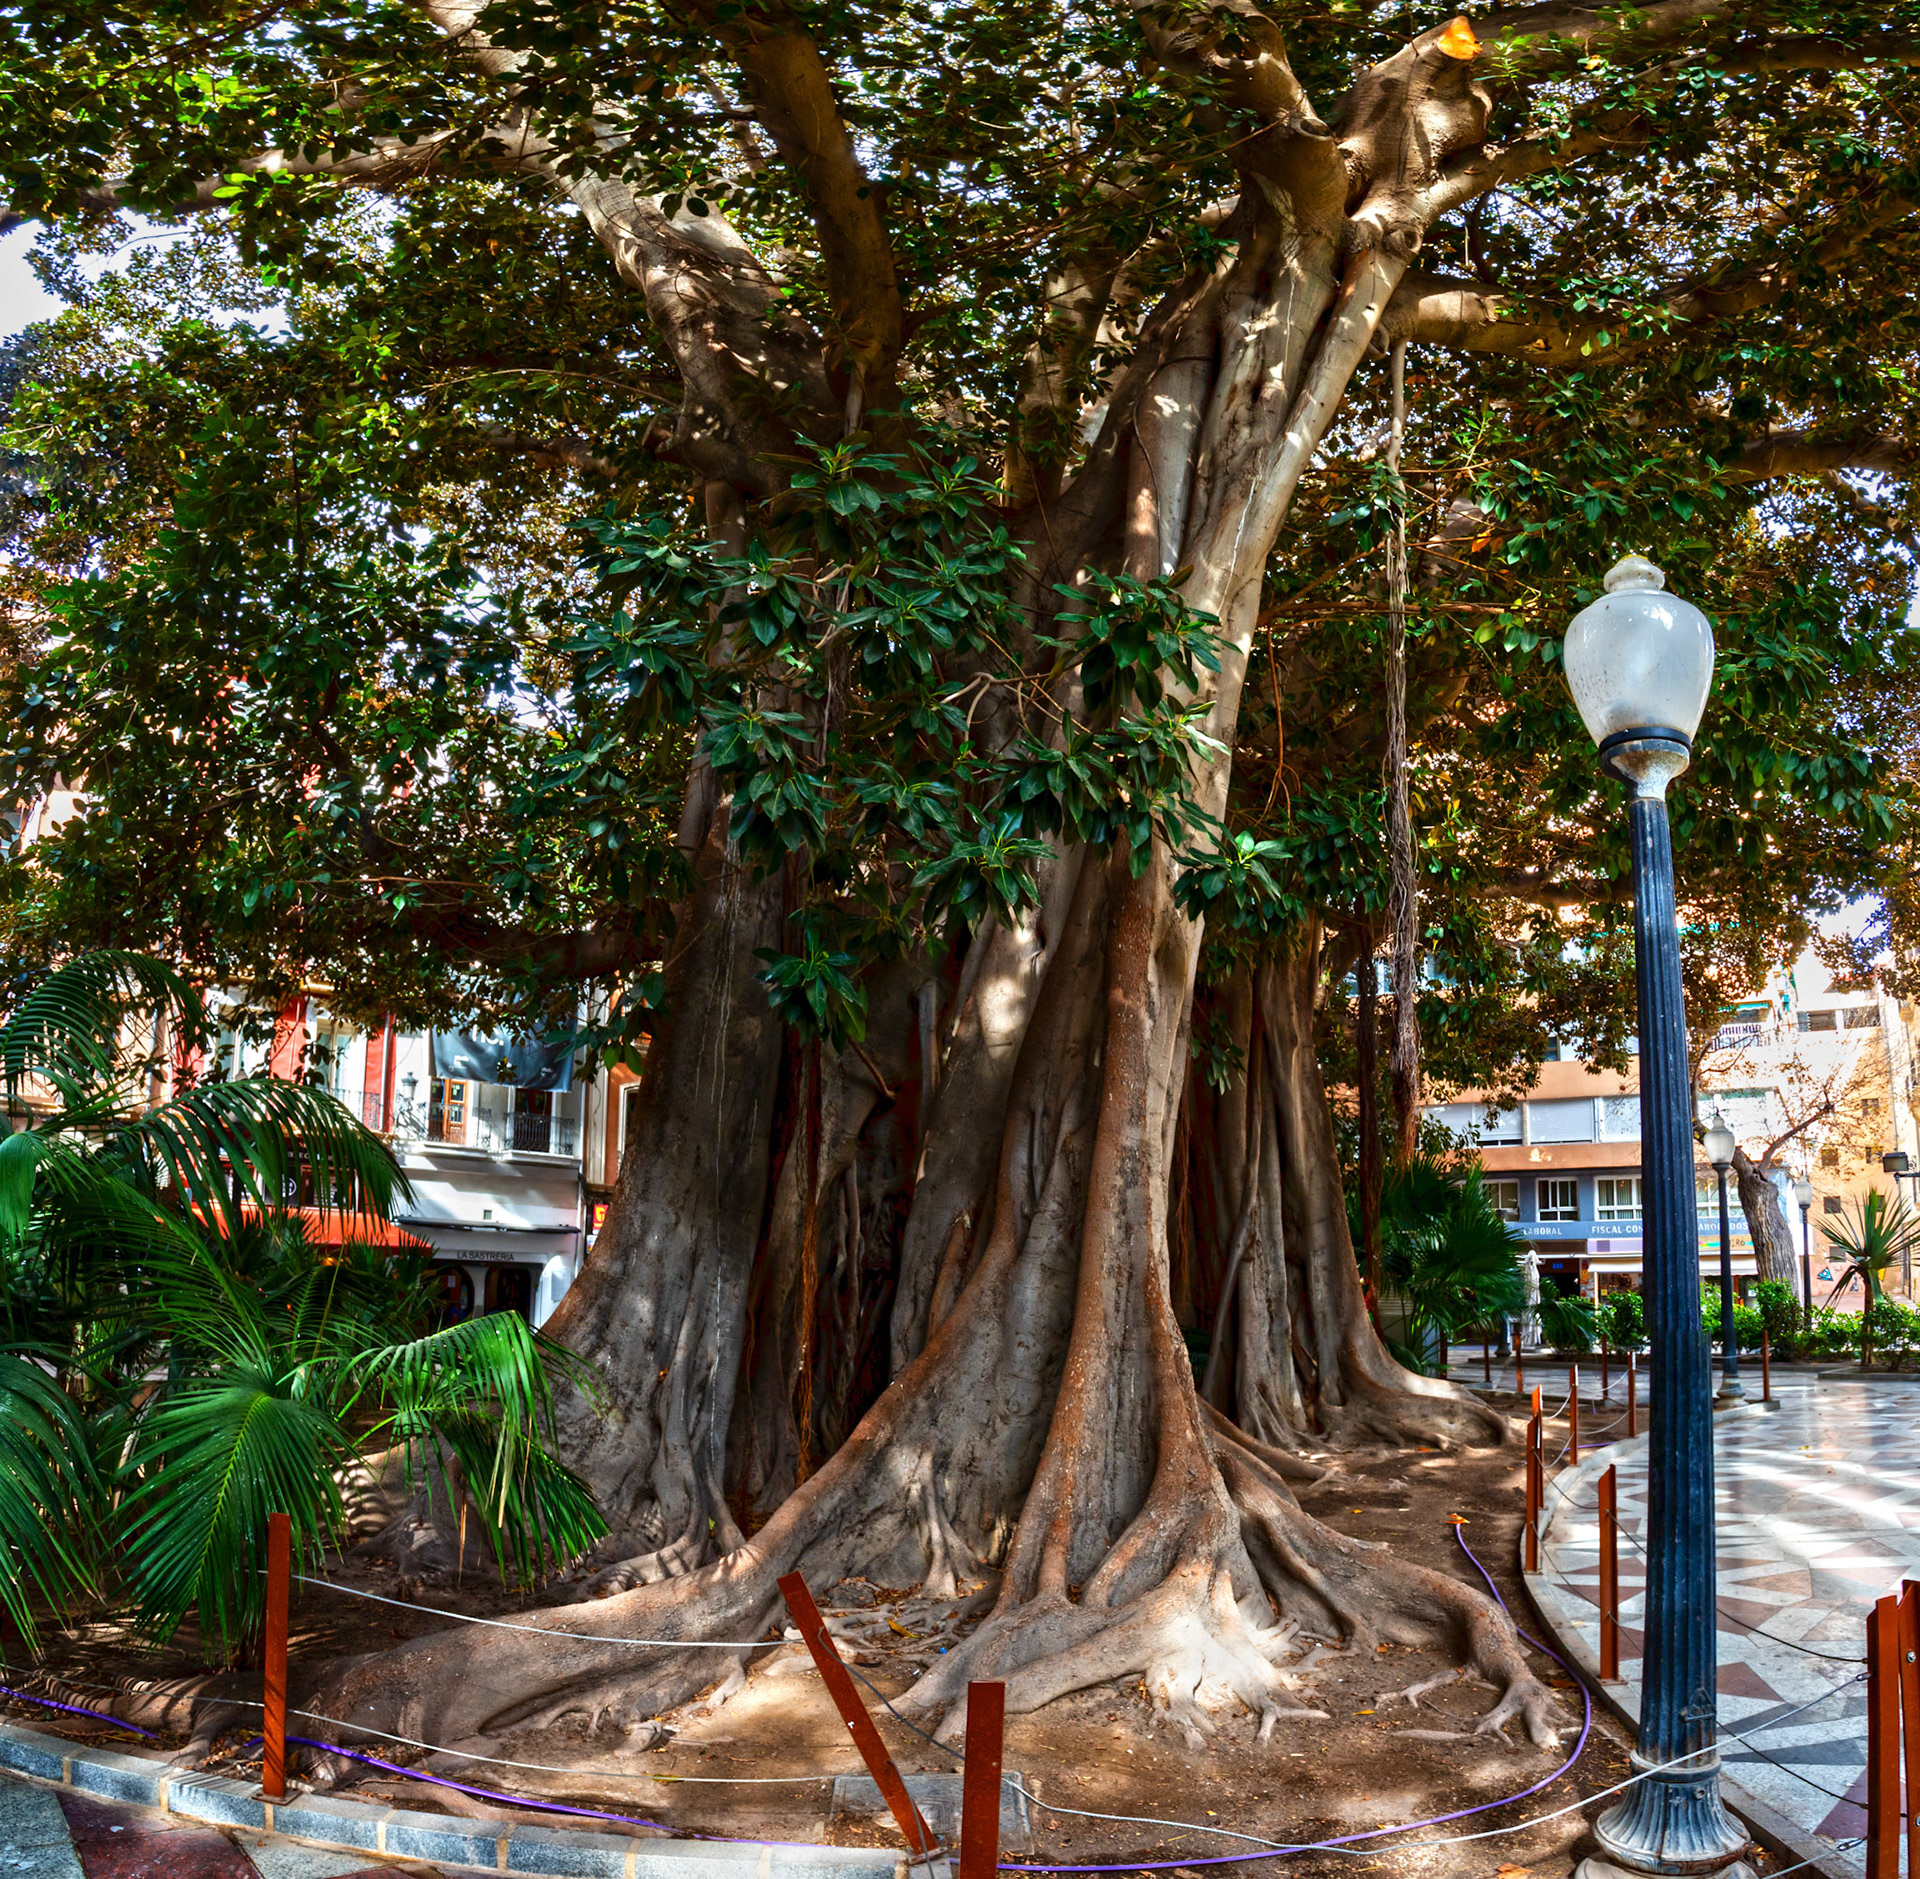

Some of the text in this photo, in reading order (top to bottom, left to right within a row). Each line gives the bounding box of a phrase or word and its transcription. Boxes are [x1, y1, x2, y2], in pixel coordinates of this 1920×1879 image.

[1523, 1226, 1563, 1235] LABORAL
[1698, 1222, 1749, 1231] ABODOS
[456, 1250, 515, 1261] LA SASTRERIA
